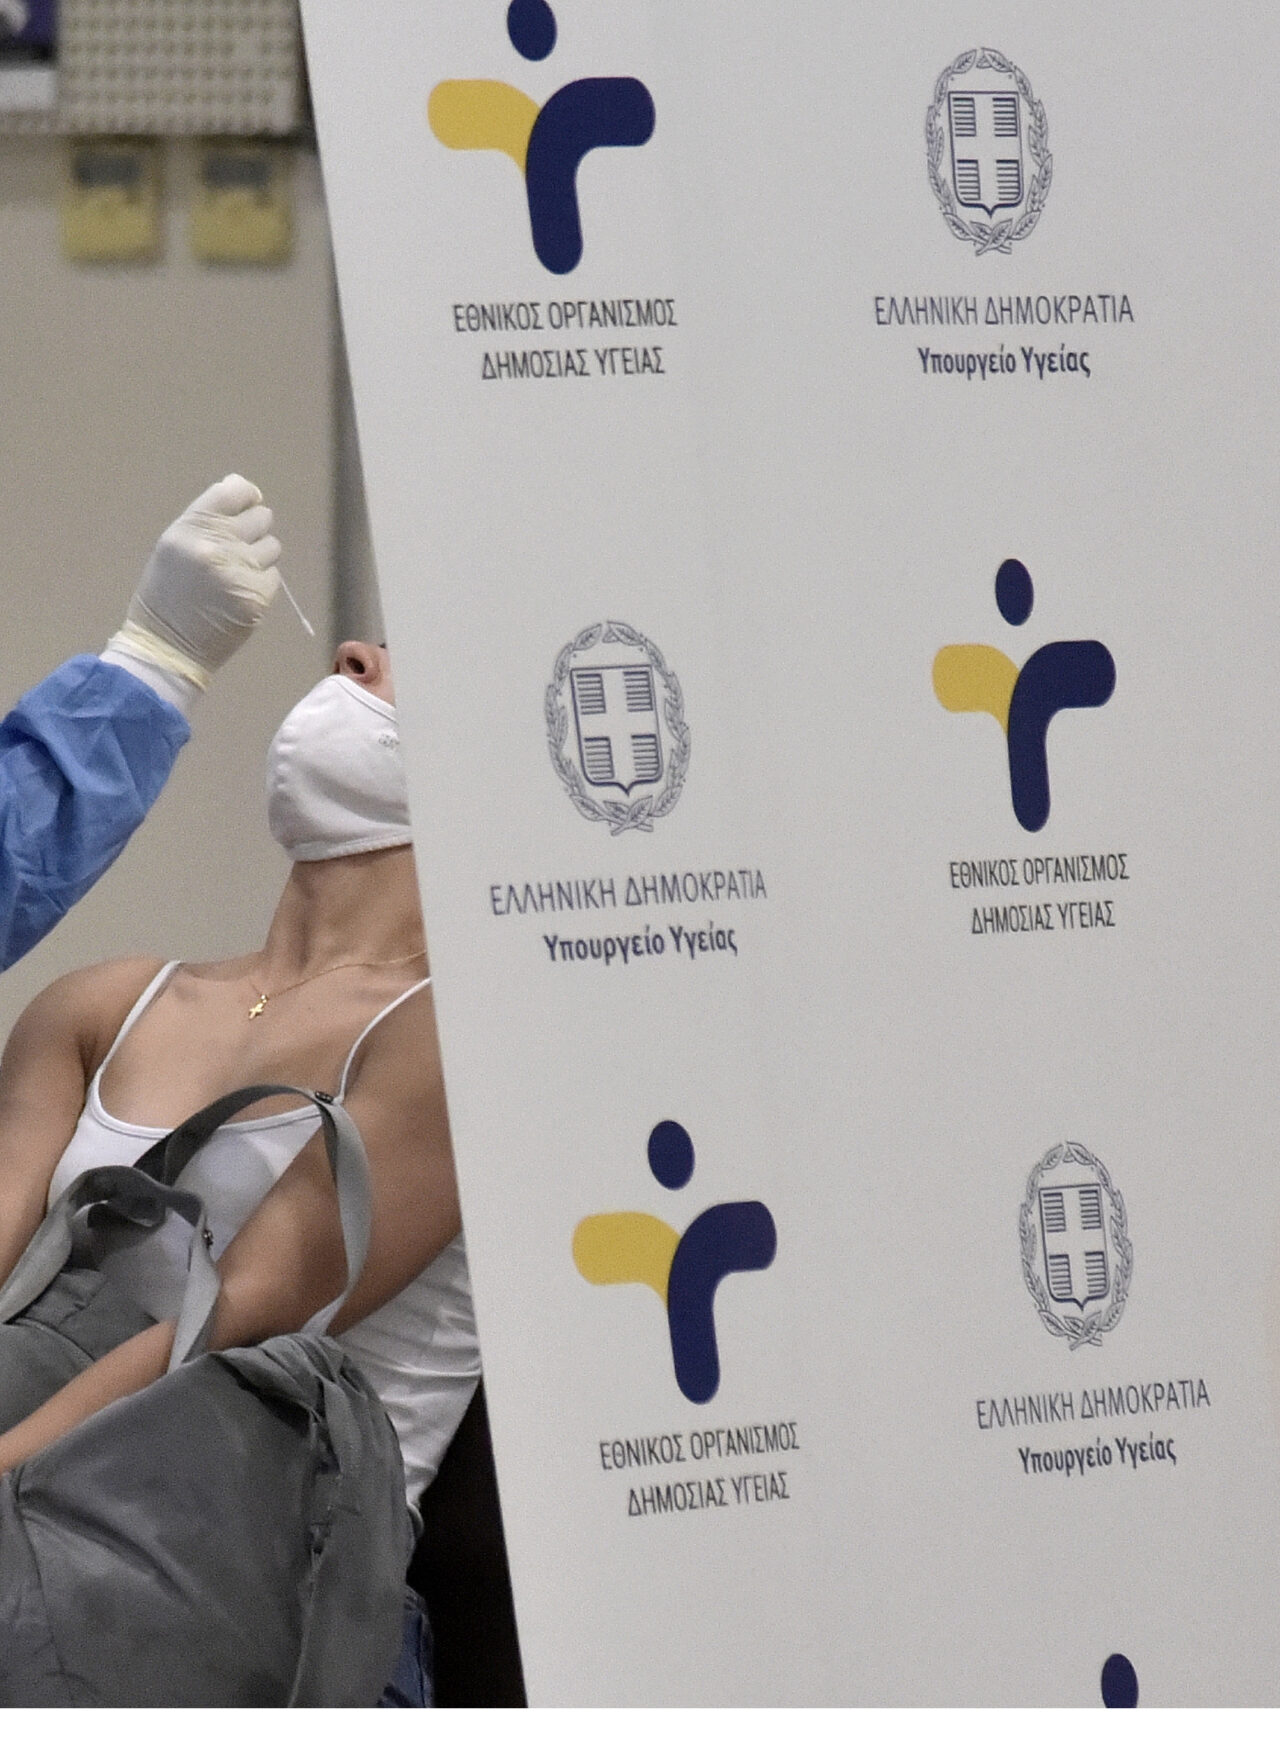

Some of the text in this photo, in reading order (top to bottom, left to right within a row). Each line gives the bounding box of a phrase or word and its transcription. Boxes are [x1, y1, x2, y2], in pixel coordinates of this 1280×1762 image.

[453, 299, 678, 332] ΕΘΝΙΚΟΣ ΟΡΓΑΝΙΣΜΟΣ
[875, 294, 1134, 325] ΕΛΛΗΝΙΚΗ ΔΗΜΟΚΡΑΤΙΑ
[482, 347, 665, 380] ΔΗΜΟΣΙΑΣ ΥΓΕΙΑΣ
[917, 342, 1091, 380] Υπουργείο Υγείας
[950, 853, 1130, 888] ΕΘΝΙΚΟΣ ΟΡΓΑΝΙΣΜΟΣ
[490, 869, 768, 916] ΕΛΛΗΝΙΚΗ ΔΗΜΟΚΡΑΤΙΑ
[972, 901, 1115, 935] ΔΗΜΟΣΙΑΣ ΥΓΕΙΑΣ
[543, 921, 738, 966] Υπουργείο Υγείας
[976, 1378, 1211, 1430] ΕΛΛΗΝΙΚΗ ΔΗΜΟΚΡΑΤΙΑ
[599, 1421, 800, 1471] ΕΘΝΙΚΟΣ ΟΡΓΑΝΙΣΜΟΣ
[1019, 1431, 1177, 1477] Υπουργείο Υγείας
[628, 1471, 790, 1516] ΔΗΜΟΣΙΑΣ ΥΓΕΙΑΣ
